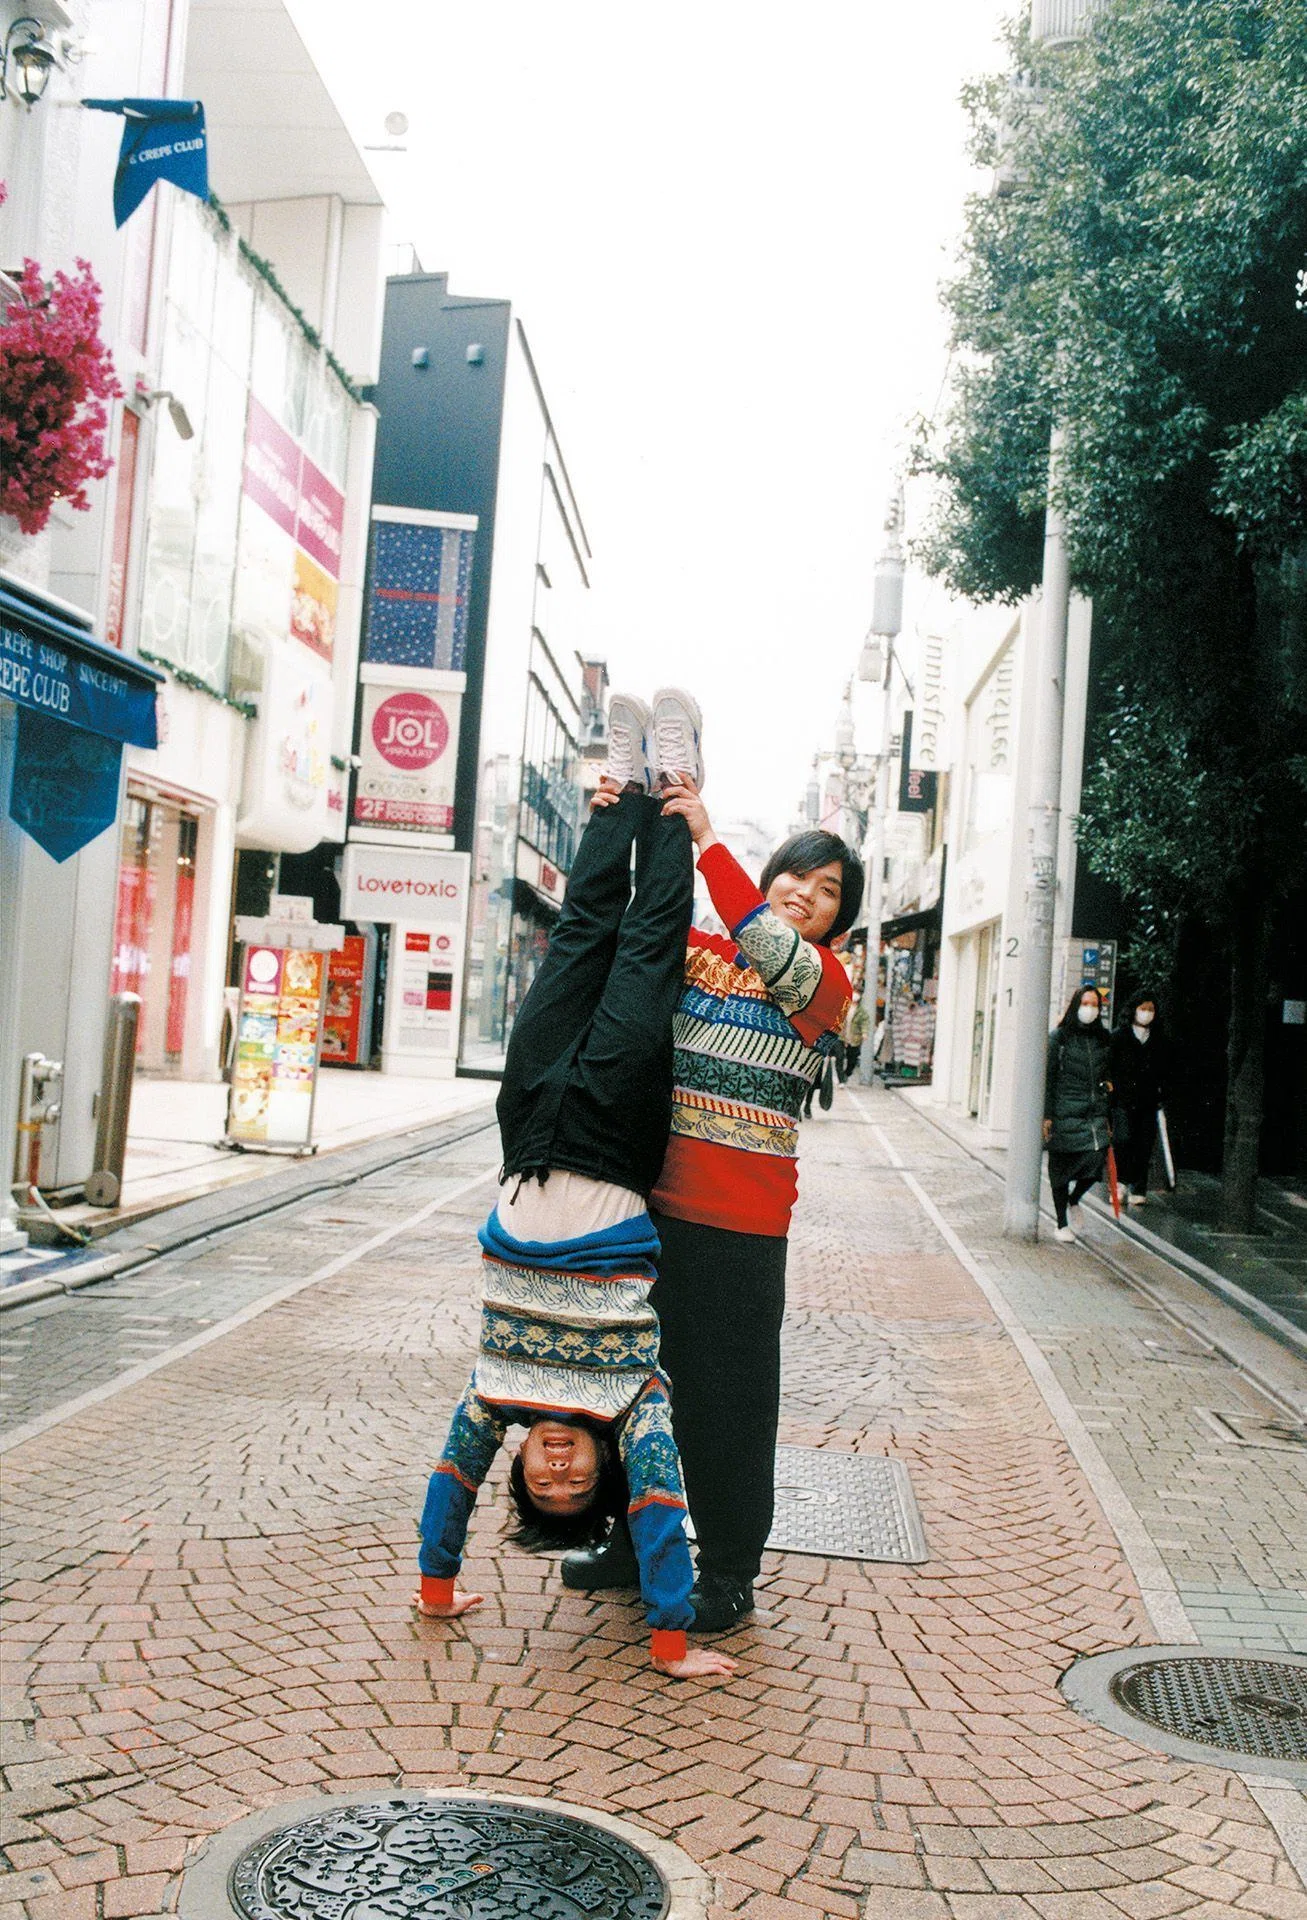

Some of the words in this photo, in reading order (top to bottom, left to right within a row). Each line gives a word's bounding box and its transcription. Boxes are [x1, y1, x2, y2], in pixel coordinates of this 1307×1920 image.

[173, 138, 204, 153] CLUB
[40, 644, 68, 673] SHOP
[33, 673, 70, 712] CLUB
[920, 634, 950, 763] innisfree
[381, 716, 439, 748] JOL
[357, 874, 457, 898] Lovetoxic
[1005, 937, 1019, 958] 2
[1006, 988, 1014, 1007] 1
